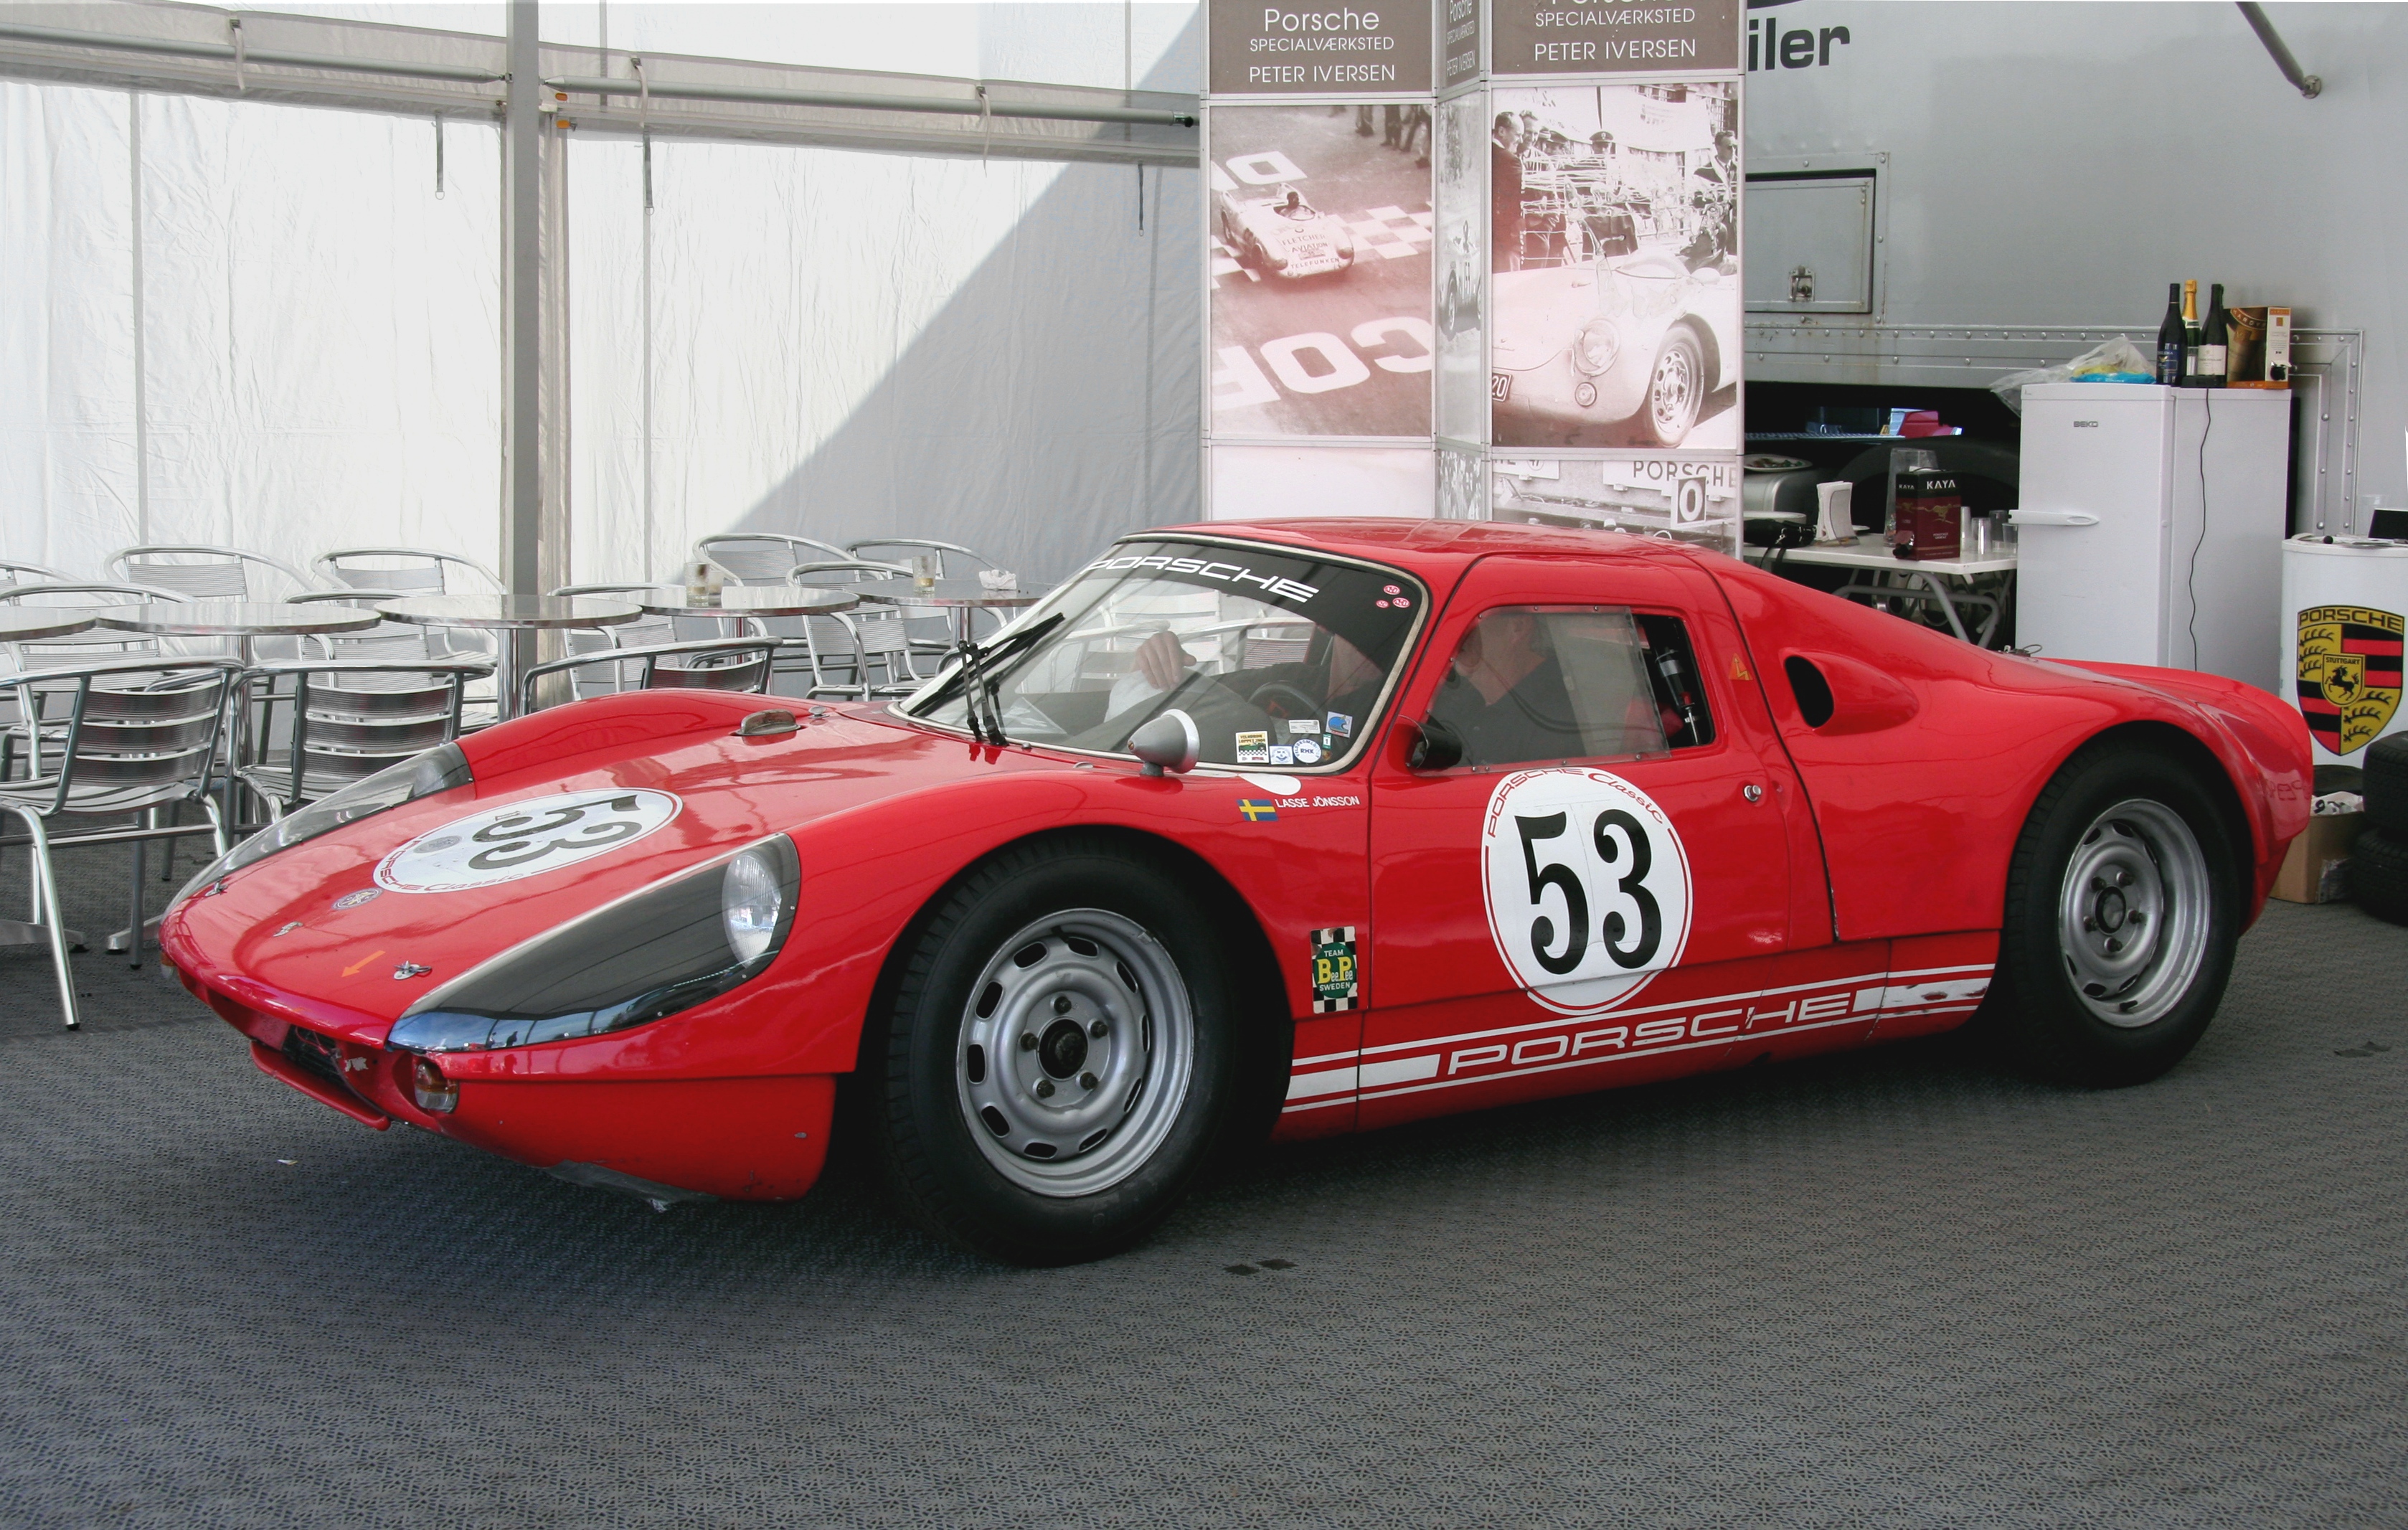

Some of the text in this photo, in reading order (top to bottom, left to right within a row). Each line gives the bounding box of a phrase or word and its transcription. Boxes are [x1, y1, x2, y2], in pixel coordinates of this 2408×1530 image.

[1265, 7, 1379, 32] Porsche
[1535, 8, 1695, 27] SPECIALVÆRKSTED
[1250, 37, 1394, 52] SPECIALVÆRKSTED
[1534, 39, 1696, 61] PETER IVERSEN
[1748, 17, 1851, 72] iler
[1250, 65, 1395, 82] PETER IVERSEN
[1282, 234, 1326, 245] FLETCHER
[1292, 242, 1328, 252] AVIATION
[1291, 258, 1340, 269] TELEFUNKEN
[1926, 480, 1955, 490] KAYA
[1080, 556, 1319, 603] PORSCHE
[2298, 608, 2402, 631] PORSCHE
[2326, 656, 2360, 666] STUTTGART
[1275, 795, 1360, 808] LASSE JÖNSSON
[1488, 768, 1663, 839] PORSCHE Classic
[468, 795, 642, 869] 53
[1514, 808, 1662, 975] 53
[1319, 981, 1351, 991] SWEDEN
[1448, 993, 1851, 1075] PORSCHE
